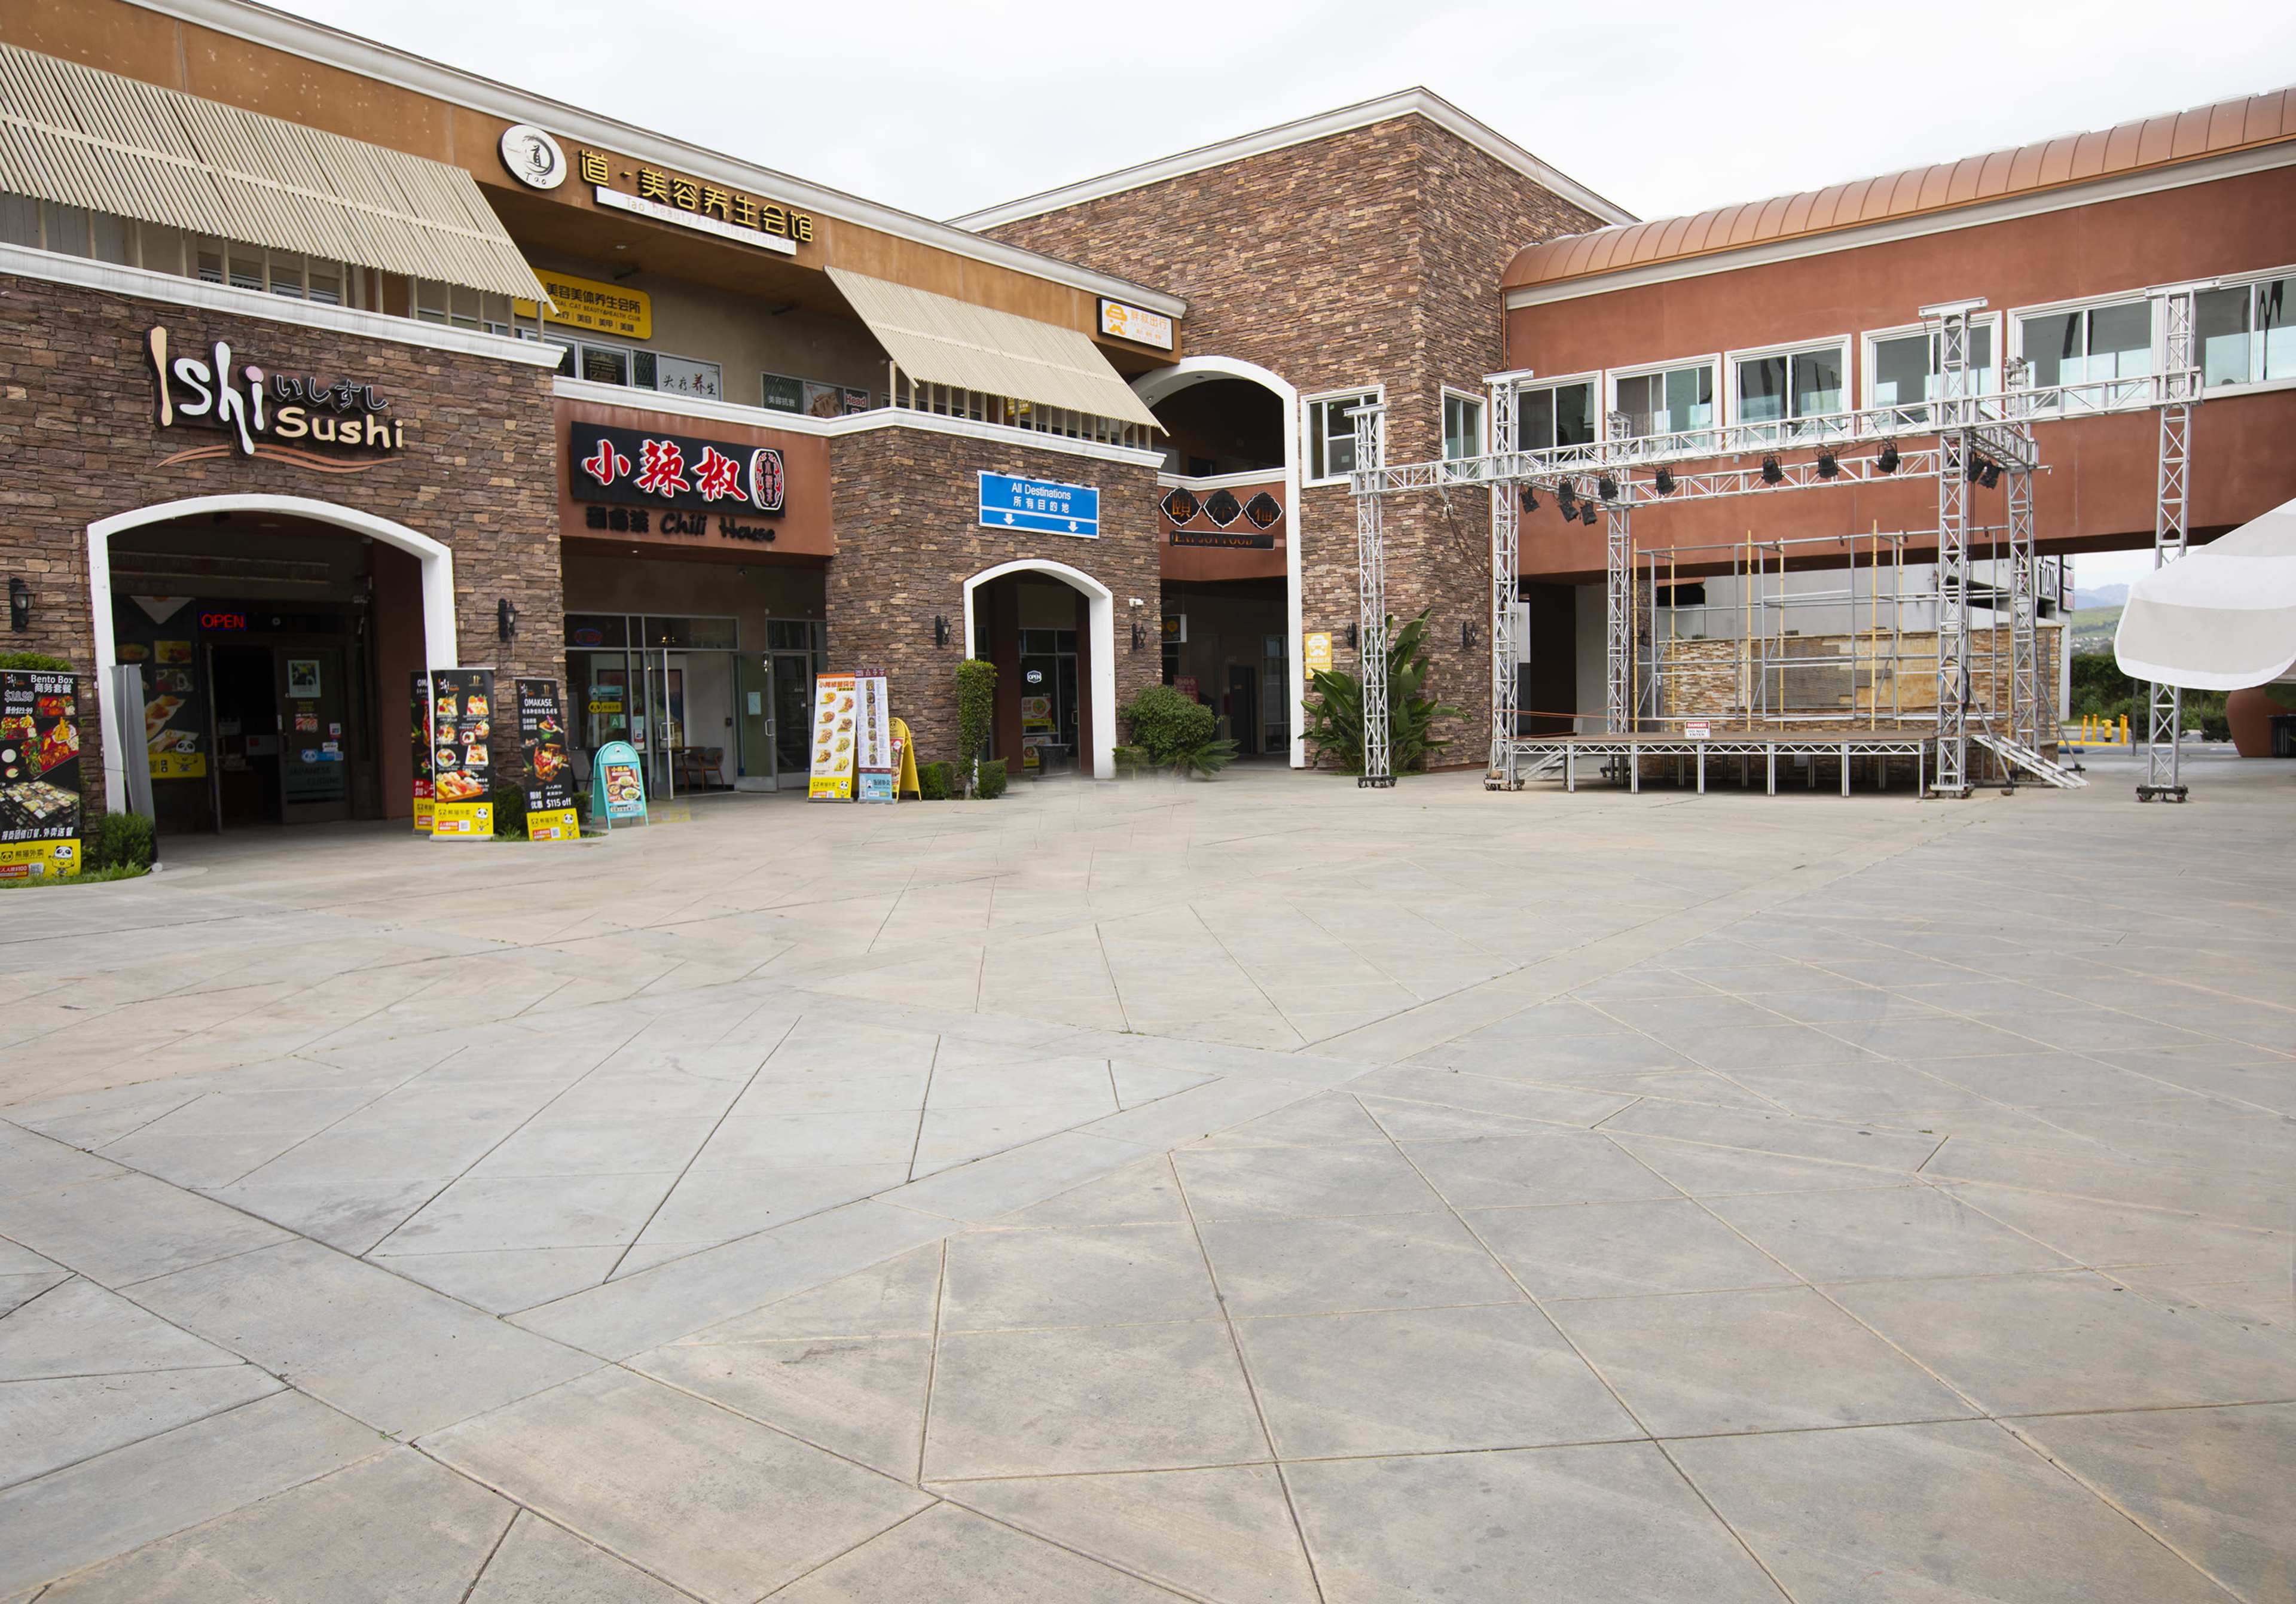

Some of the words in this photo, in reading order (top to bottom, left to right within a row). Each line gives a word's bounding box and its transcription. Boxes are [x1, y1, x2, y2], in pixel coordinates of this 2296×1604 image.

[526, 172, 546, 185] Tao
[625, 196, 645, 212] Tao
[145, 326, 265, 456] Ishi
[272, 374, 390, 414] いしすし
[845, 394, 866, 408] Head
[274, 406, 404, 450] Sushi
[582, 438, 749, 502] 小辣椒
[1011, 482, 1022, 493] All
[1024, 484, 1071, 501] Destinations
[1013, 496, 1070, 514] 所有目的地
[660, 511, 707, 536] Chili
[719, 516, 776, 542] House
[201, 614, 245, 629] OPEN
[31, 674, 56, 684] Bento
[58, 675, 74, 684] Box
[35, 683, 72, 694] 商务套餐
[524, 698, 553, 707] OMAKASE
[612, 718, 619, 726] A
[546, 798, 561, 809] $115
[562, 797, 572, 806] off
